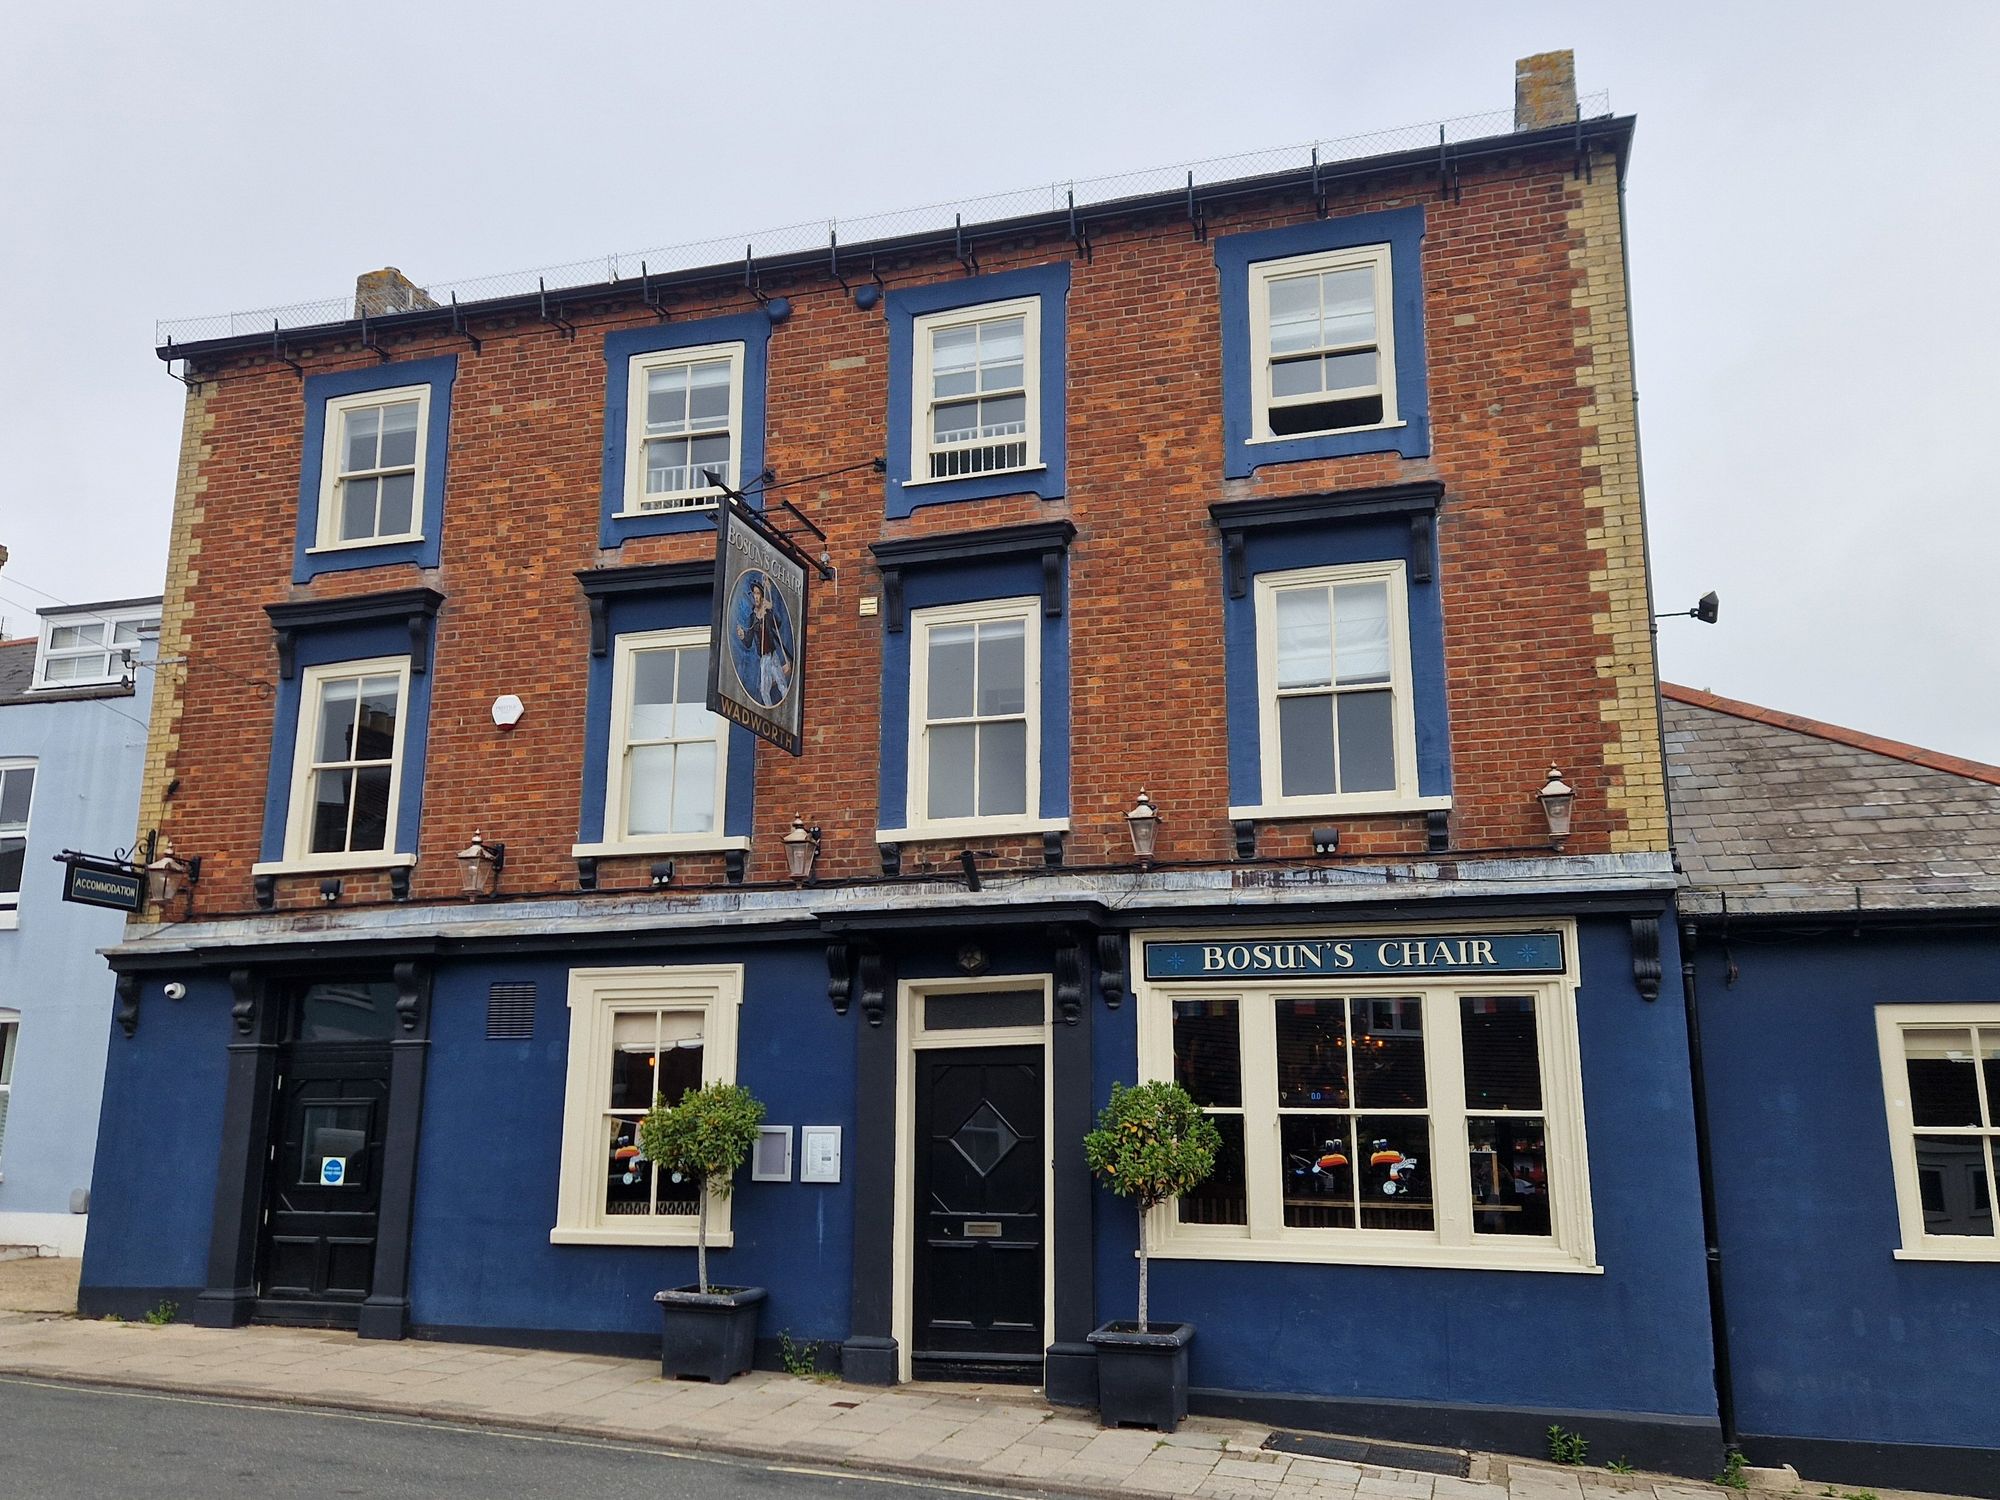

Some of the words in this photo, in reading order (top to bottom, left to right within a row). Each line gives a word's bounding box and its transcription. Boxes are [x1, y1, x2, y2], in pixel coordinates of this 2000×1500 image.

[771, 560, 802, 598] CHAIR
[720, 696, 793, 750] WADWORTH
[75, 877, 136, 898] ACCOMMODATION
[1202, 942, 1355, 971] BOSUN'S
[1377, 940, 1498, 967] CHAIR
